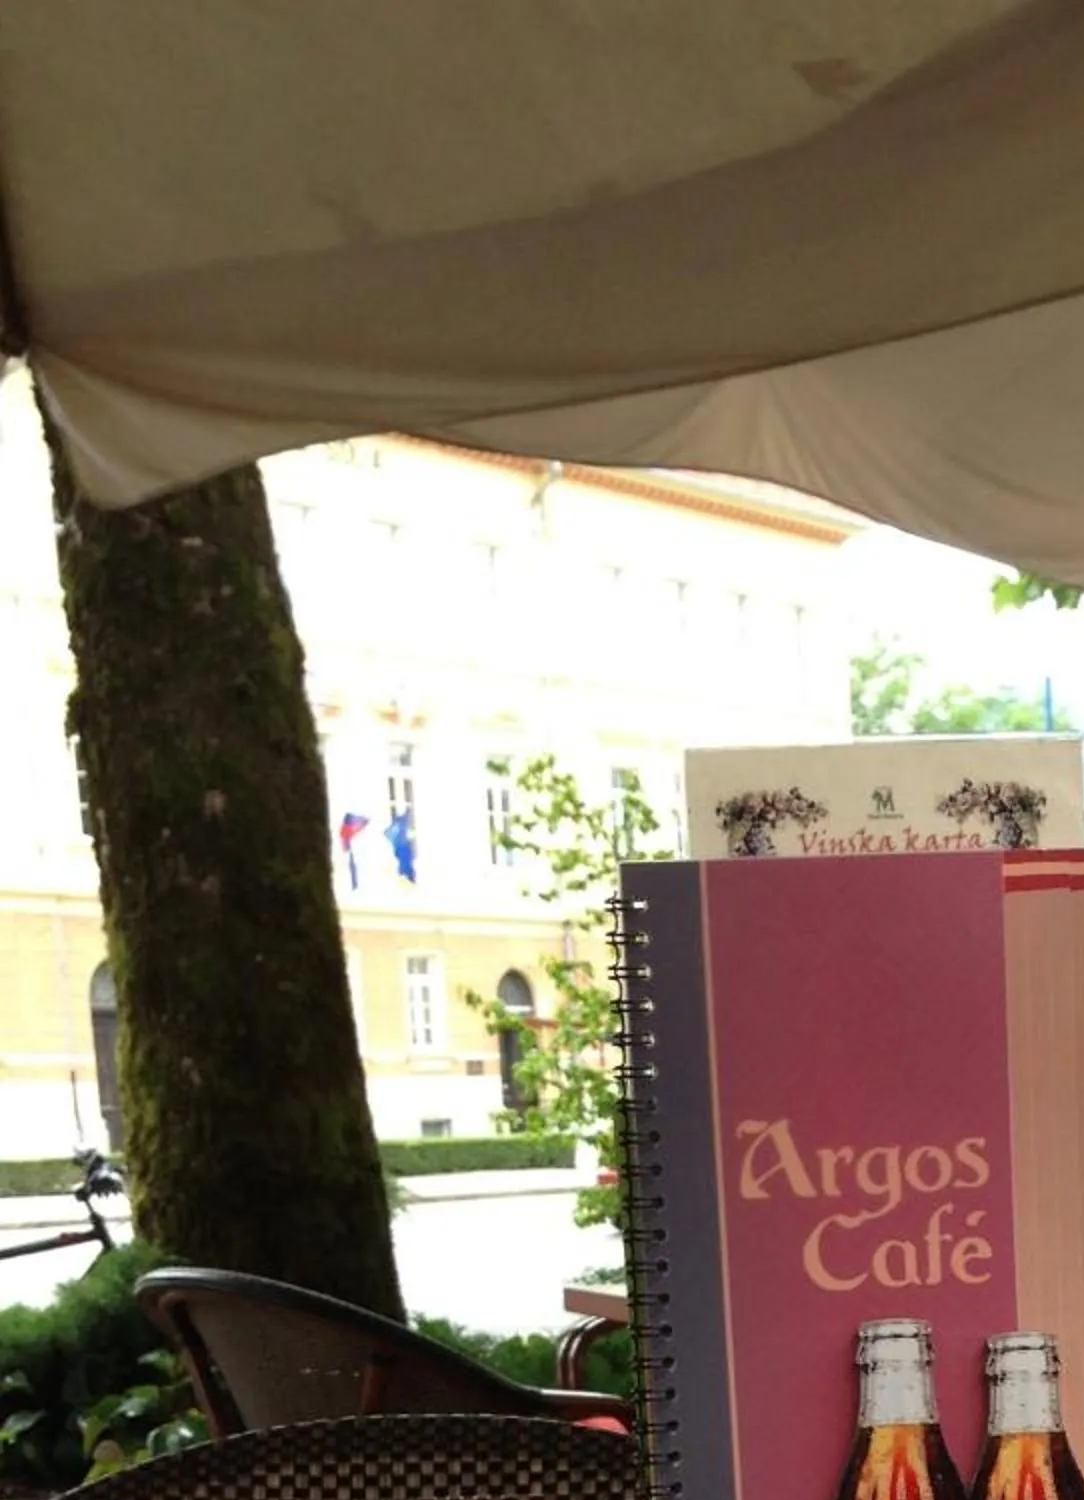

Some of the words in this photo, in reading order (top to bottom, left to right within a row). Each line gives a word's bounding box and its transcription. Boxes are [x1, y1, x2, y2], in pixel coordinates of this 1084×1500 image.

[799, 826, 896, 854] Vinska
[903, 825, 984, 850] karta
[735, 1118, 990, 1226] Argos
[803, 1202, 993, 1292] Café
